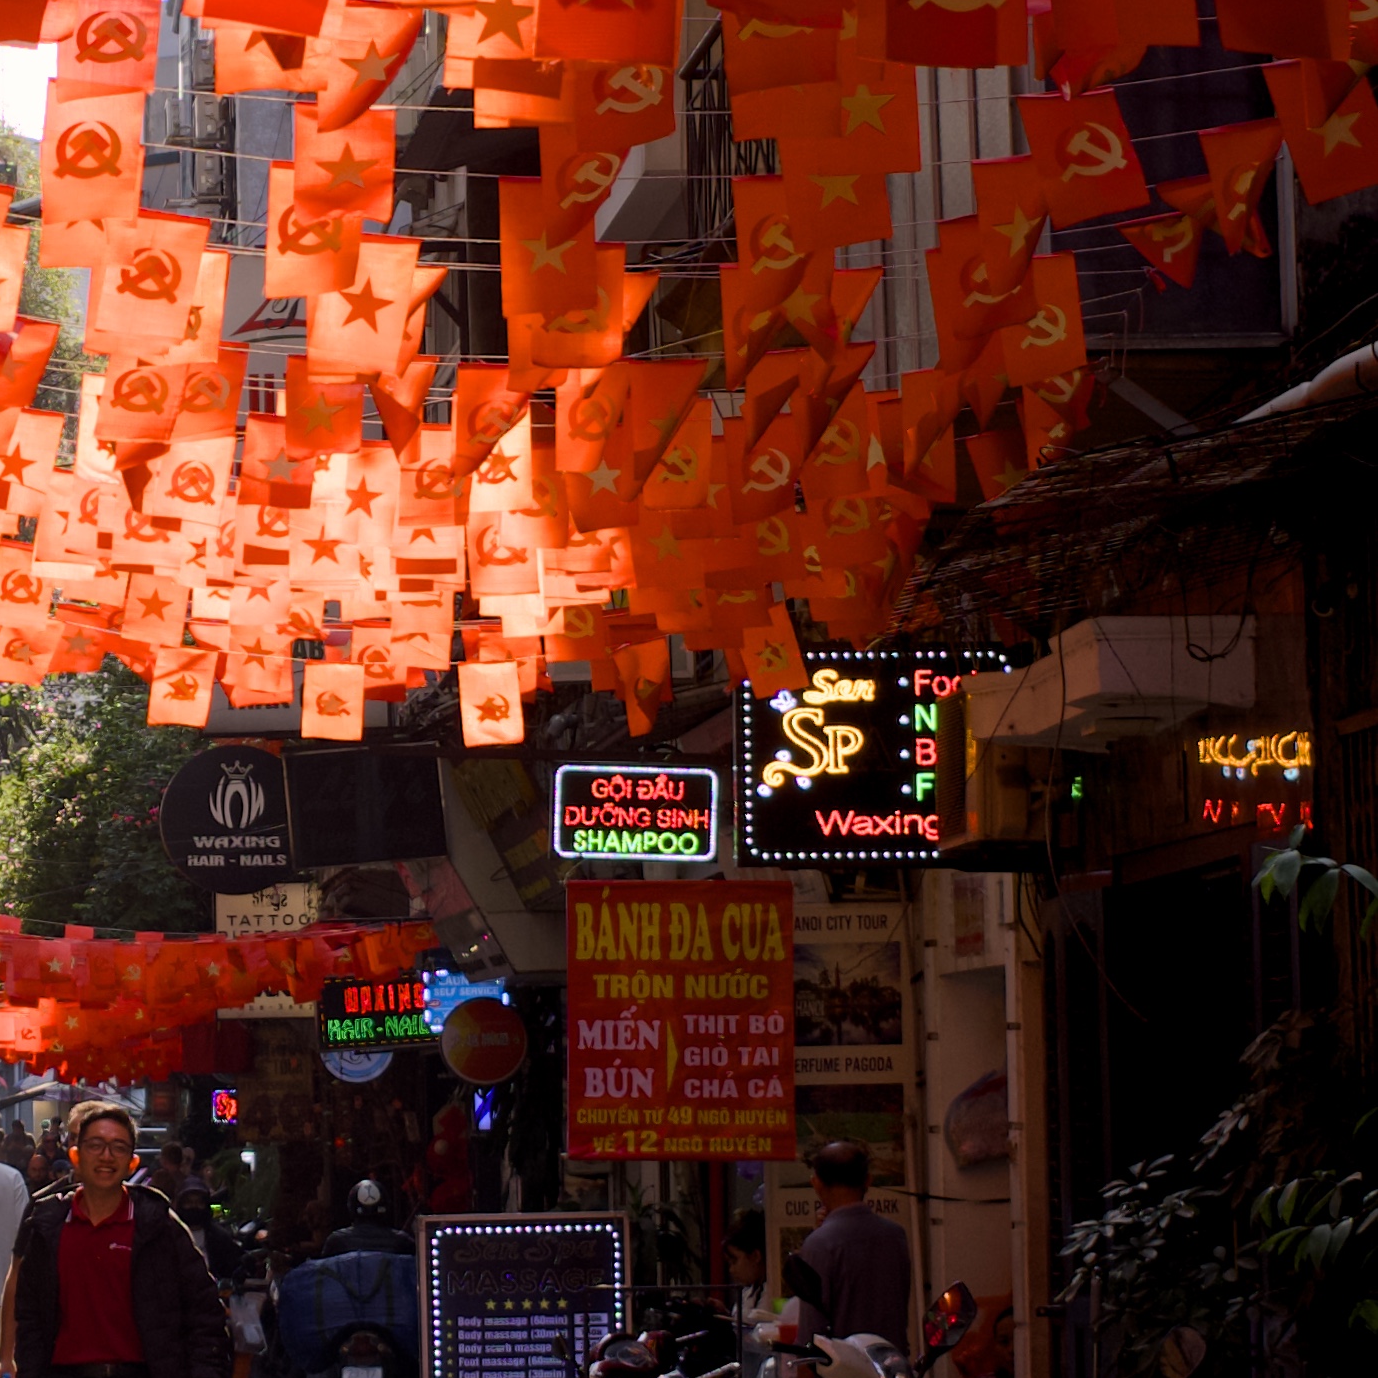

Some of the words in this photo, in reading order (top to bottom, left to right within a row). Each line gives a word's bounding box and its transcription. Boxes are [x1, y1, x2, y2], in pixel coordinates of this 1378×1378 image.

[803, 668, 876, 705] Sen
[656, 807, 710, 830] SINH
[815, 809, 940, 841] Waxing
[192, 835, 281, 850] WAXING
[573, 829, 700, 855] SHAMPOO
[187, 854, 225, 867] HAIR
[239, 853, 287, 867] NAILS
[575, 886, 661, 961] BÁNH
[669, 902, 713, 961] ĐA
[723, 903, 785, 961] CUA
[826, 915, 852, 930] CITY
[857, 914, 888, 930] TOUR
[460, 986, 499, 996] SERVICE
[593, 969, 674, 1004] TRỘN
[684, 968, 769, 999] NƯỚC
[577, 1005, 661, 1051] MIẾN
[683, 1014, 740, 1039] THỊT
[749, 1010, 785, 1034] BÒ
[683, 1043, 728, 1067] GIÒ
[738, 1046, 779, 1067] TAI
[845, 1056, 893, 1072] PAGODA
[584, 1058, 654, 1098] BÚN
[683, 1070, 739, 1098] CHẢ
[748, 1073, 785, 1098] CÁ
[667, 1105, 693, 1124] 49
[697, 1107, 731, 1125] NGÕ
[735, 1107, 788, 1127] HUYỆN
[622, 1130, 659, 1153] 12
[664, 1134, 703, 1153] NGÕ
[709, 1134, 772, 1156] HUYỆN
[785, 1200, 809, 1216] CUC
[453, 1235, 519, 1262] Sen
[524, 1234, 598, 1265] Spa
[447, 1267, 605, 1295] MASSAGE
[457, 1315, 482, 1327] Body
[457, 1329, 482, 1341] Body
[458, 1343, 482, 1354] Body
[458, 1356, 480, 1367] Foot
